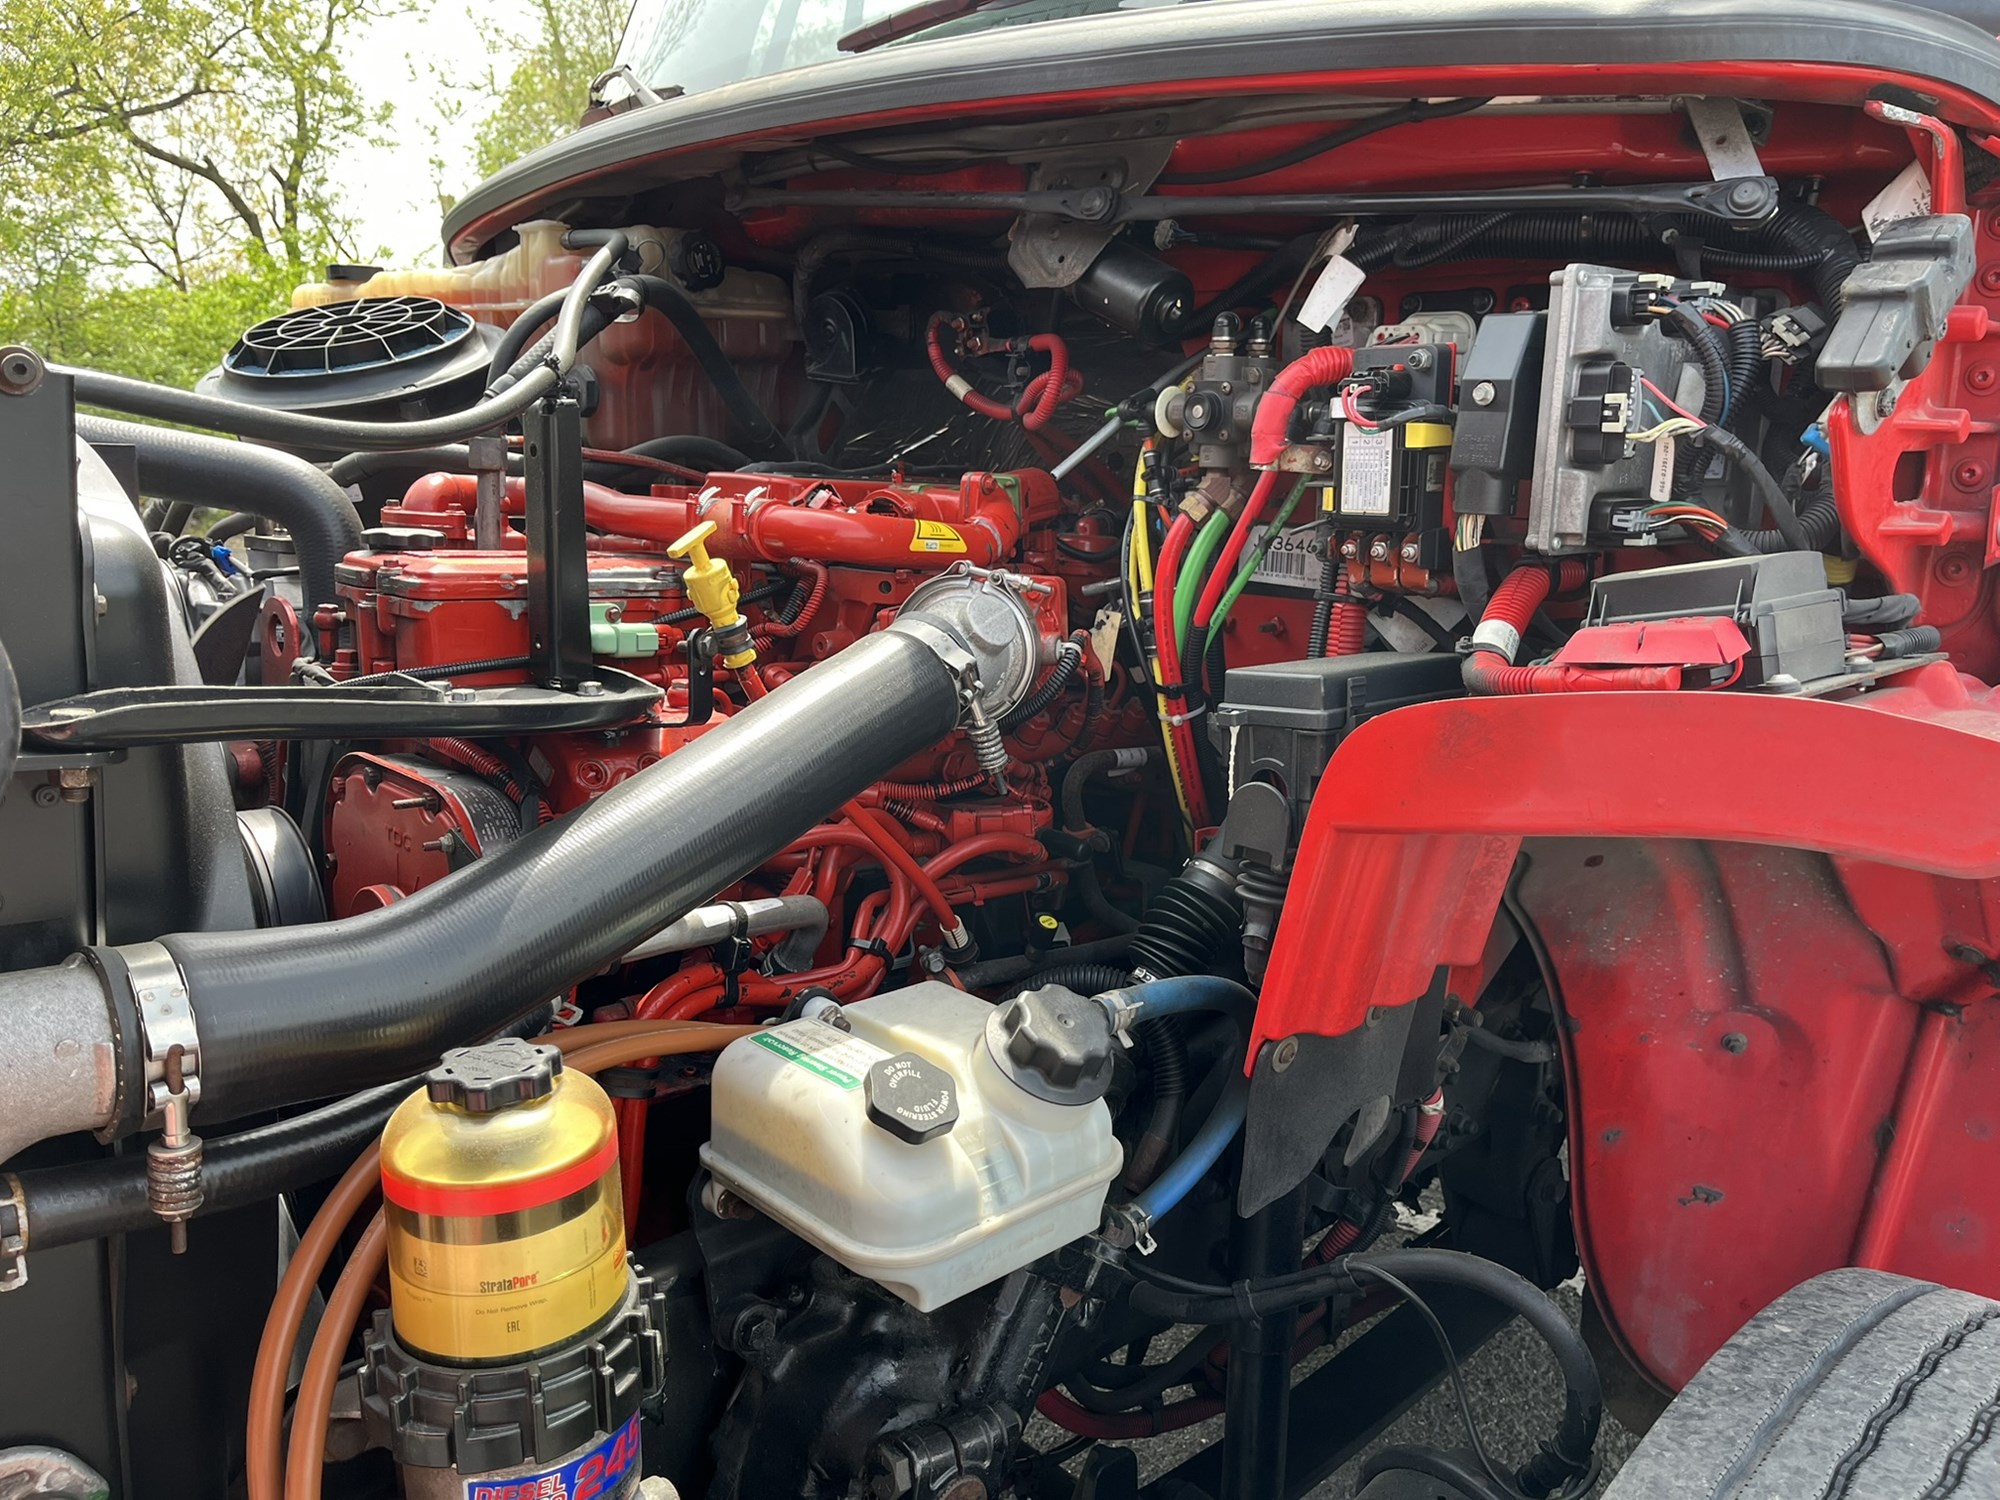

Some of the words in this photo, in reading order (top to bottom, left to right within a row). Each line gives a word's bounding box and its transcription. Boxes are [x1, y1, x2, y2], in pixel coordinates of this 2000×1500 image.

[387, 827, 412, 853] TDC
[826, 1067, 852, 1084] Power
[883, 1065, 896, 1077] DO
[894, 1060, 912, 1070] NOT
[888, 1069, 922, 1089] OVERFILL
[913, 1098, 939, 1113] FLUID
[935, 1090, 950, 1115] POWER
[896, 1106, 939, 1121] STEERING
[480, 1273, 537, 1294] StrataPore
[475, 1308, 486, 1316] Do
[486, 1307, 499, 1315] Not
[500, 1303, 528, 1313] Remove
[474, 1472, 566, 1500] DIESEL
